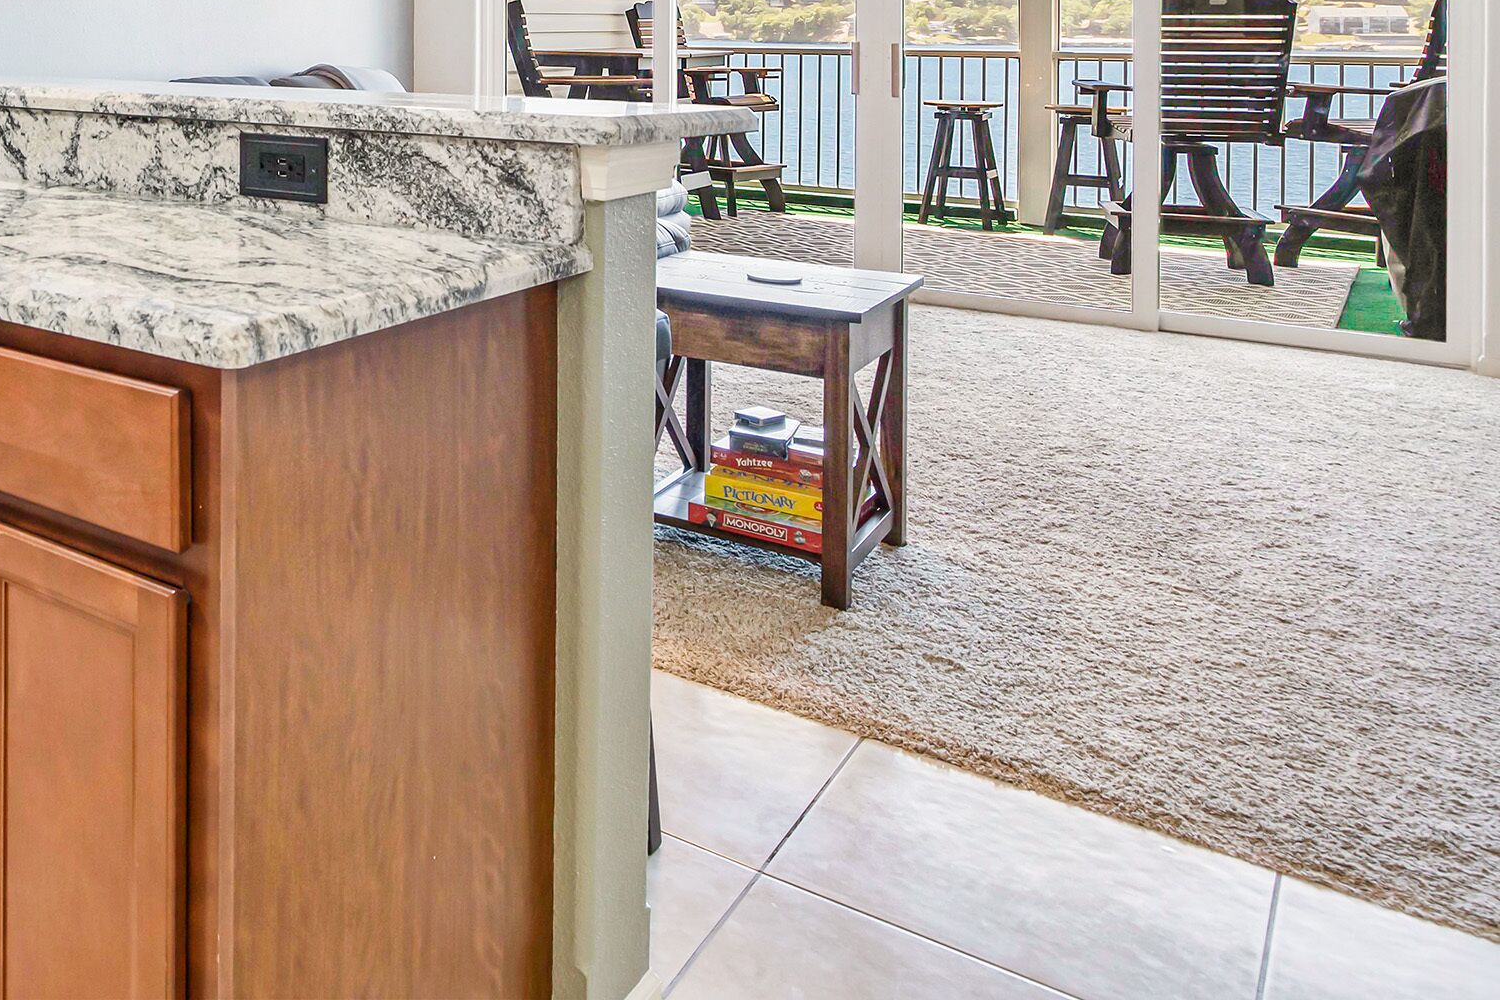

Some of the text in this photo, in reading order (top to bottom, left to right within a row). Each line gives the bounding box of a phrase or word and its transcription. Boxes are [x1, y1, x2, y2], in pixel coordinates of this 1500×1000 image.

[735, 458, 773, 467] Yahtzee
[723, 485, 796, 509] PICTIONARY
[726, 517, 785, 538] MONOPOLY
